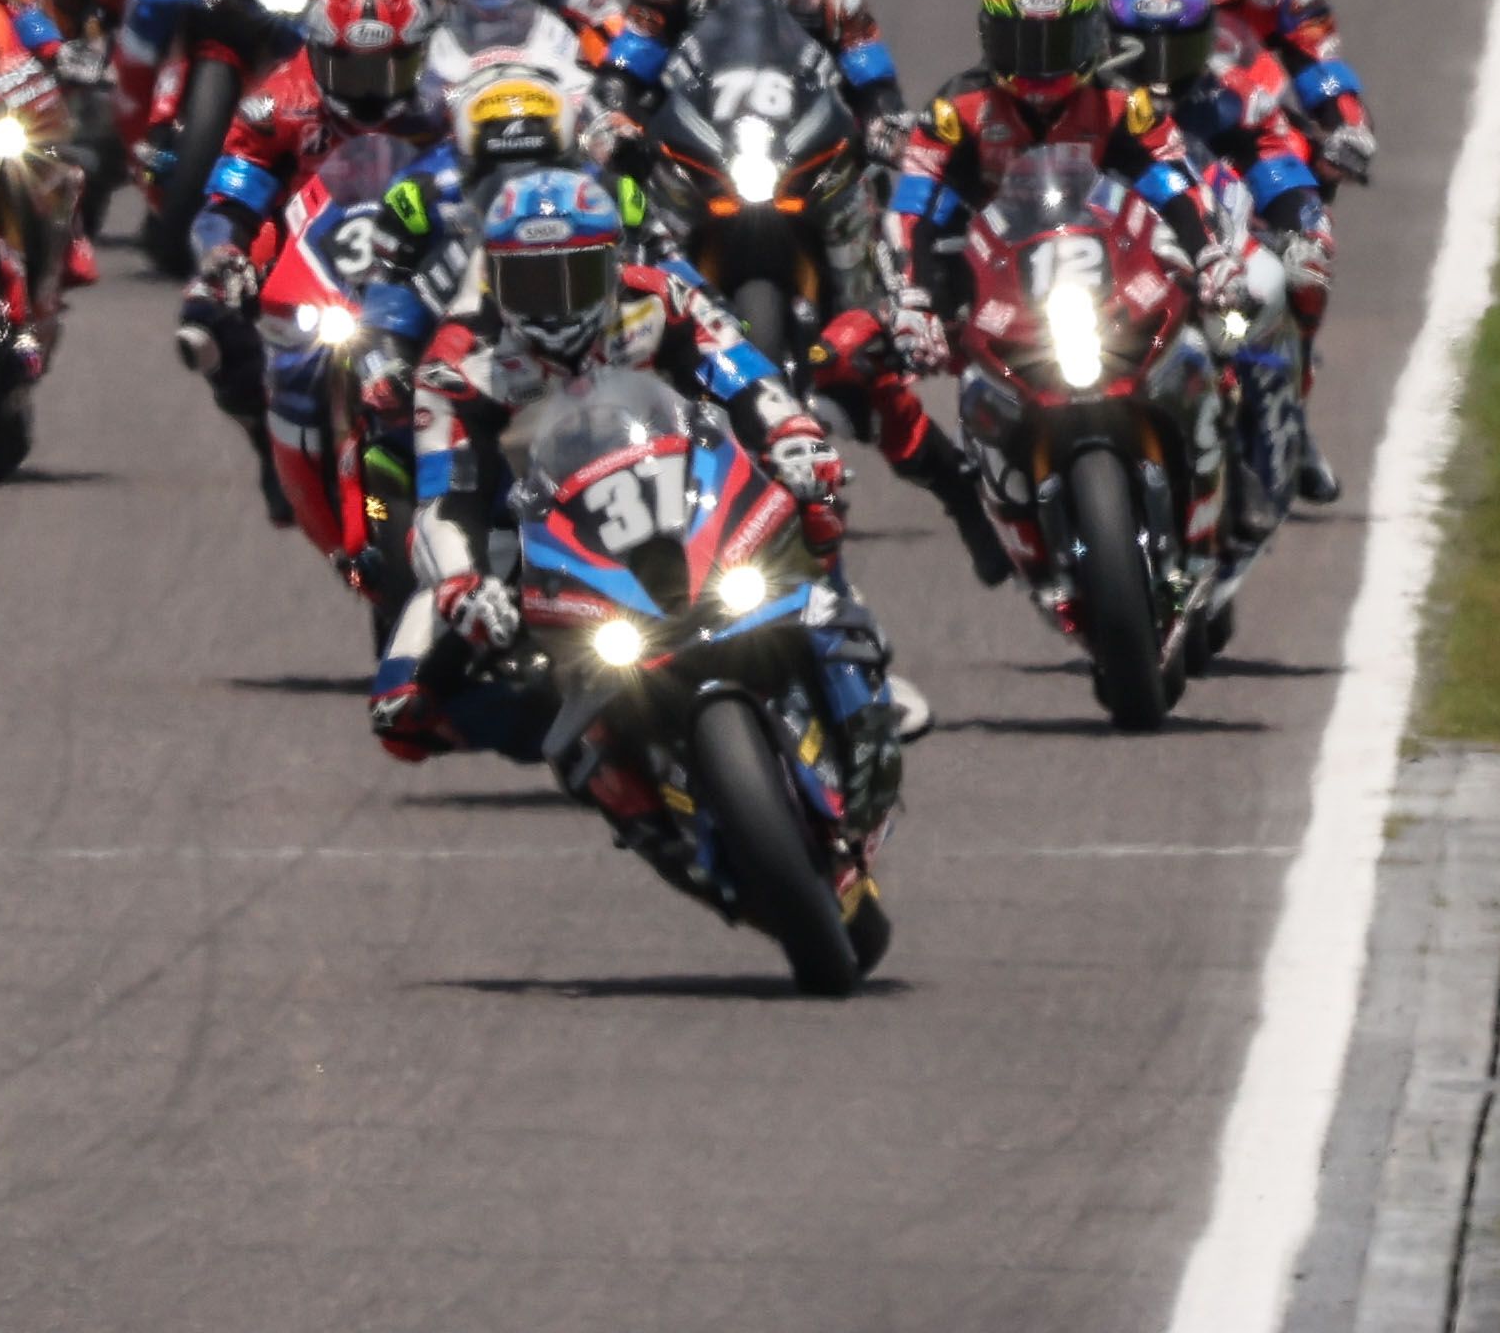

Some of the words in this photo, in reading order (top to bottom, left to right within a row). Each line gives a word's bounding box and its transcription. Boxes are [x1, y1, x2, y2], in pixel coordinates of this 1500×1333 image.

[712, 70, 794, 120] 76
[1029, 236, 1104, 297] 12
[583, 456, 686, 554] 37
